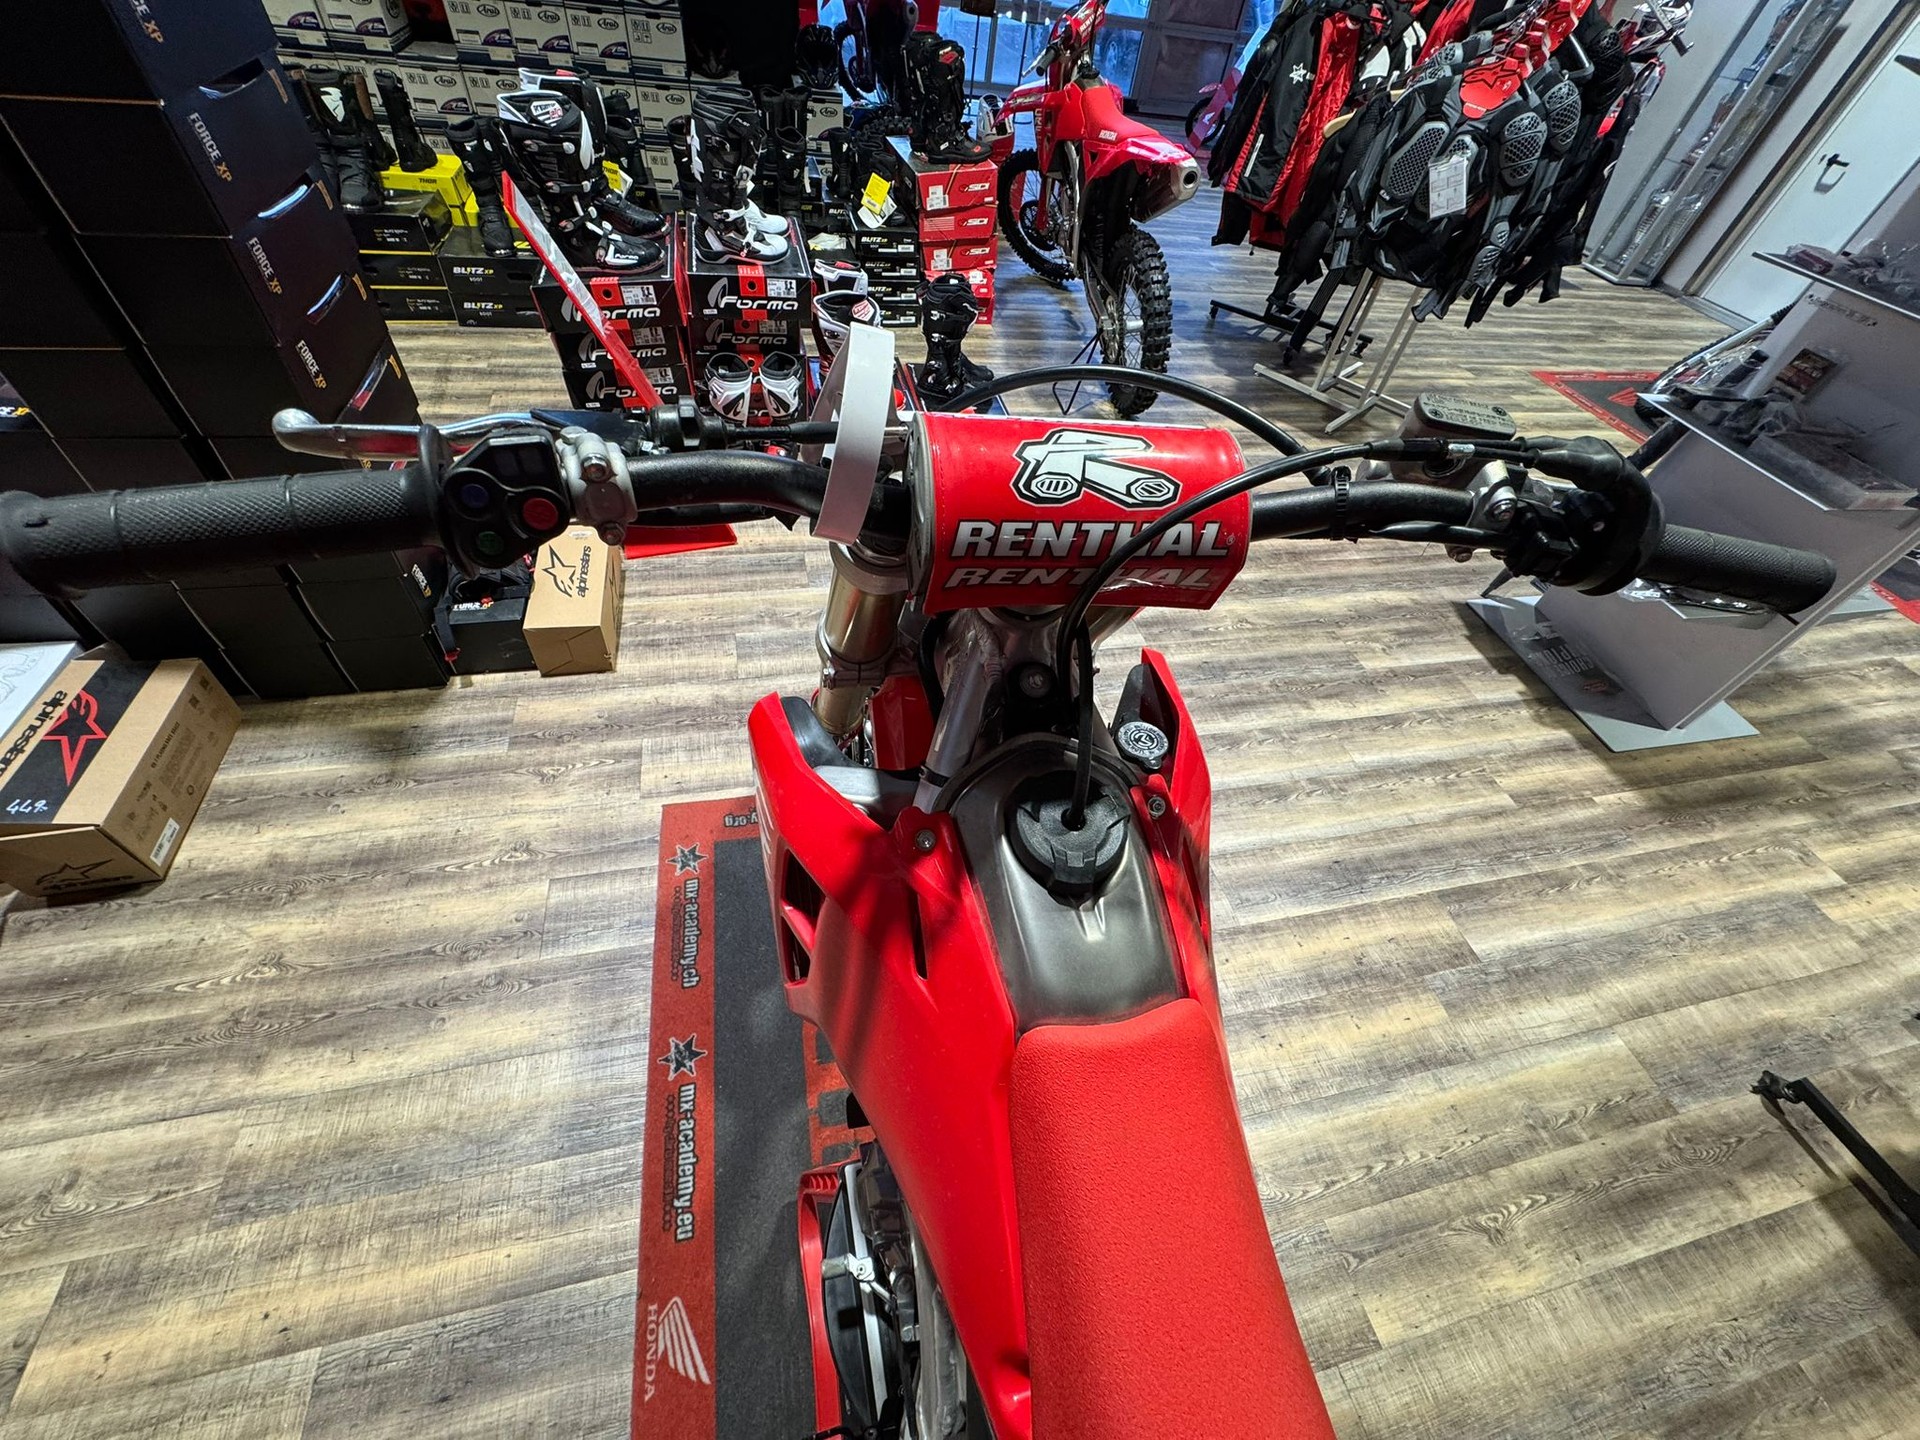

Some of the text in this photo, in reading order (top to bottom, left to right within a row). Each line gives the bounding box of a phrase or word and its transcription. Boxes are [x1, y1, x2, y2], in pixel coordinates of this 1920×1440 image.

[478, 5, 500, 17] Arai
[539, 11, 560, 22] Arai
[598, 18, 619, 29] Arai
[657, 23, 677, 34] Arai
[144, 20, 164, 44] XP
[435, 76, 456, 86] Arai
[497, 79, 517, 90] Arai
[820, 107, 838, 116] Arai
[190, 112, 233, 183] FORCE XP
[249, 237, 282, 295] FORCE XP
[453, 266, 485, 275] BLITZ
[463, 302, 494, 310] BLITZ
[297, 339, 327, 389] FORCE XP
[576, 545, 592, 598] alpinestars
[681, 877, 701, 990] mx-academy.ch
[673, 1082, 698, 1243] mx-academy.eu
[644, 1303, 659, 1402] HONDA
